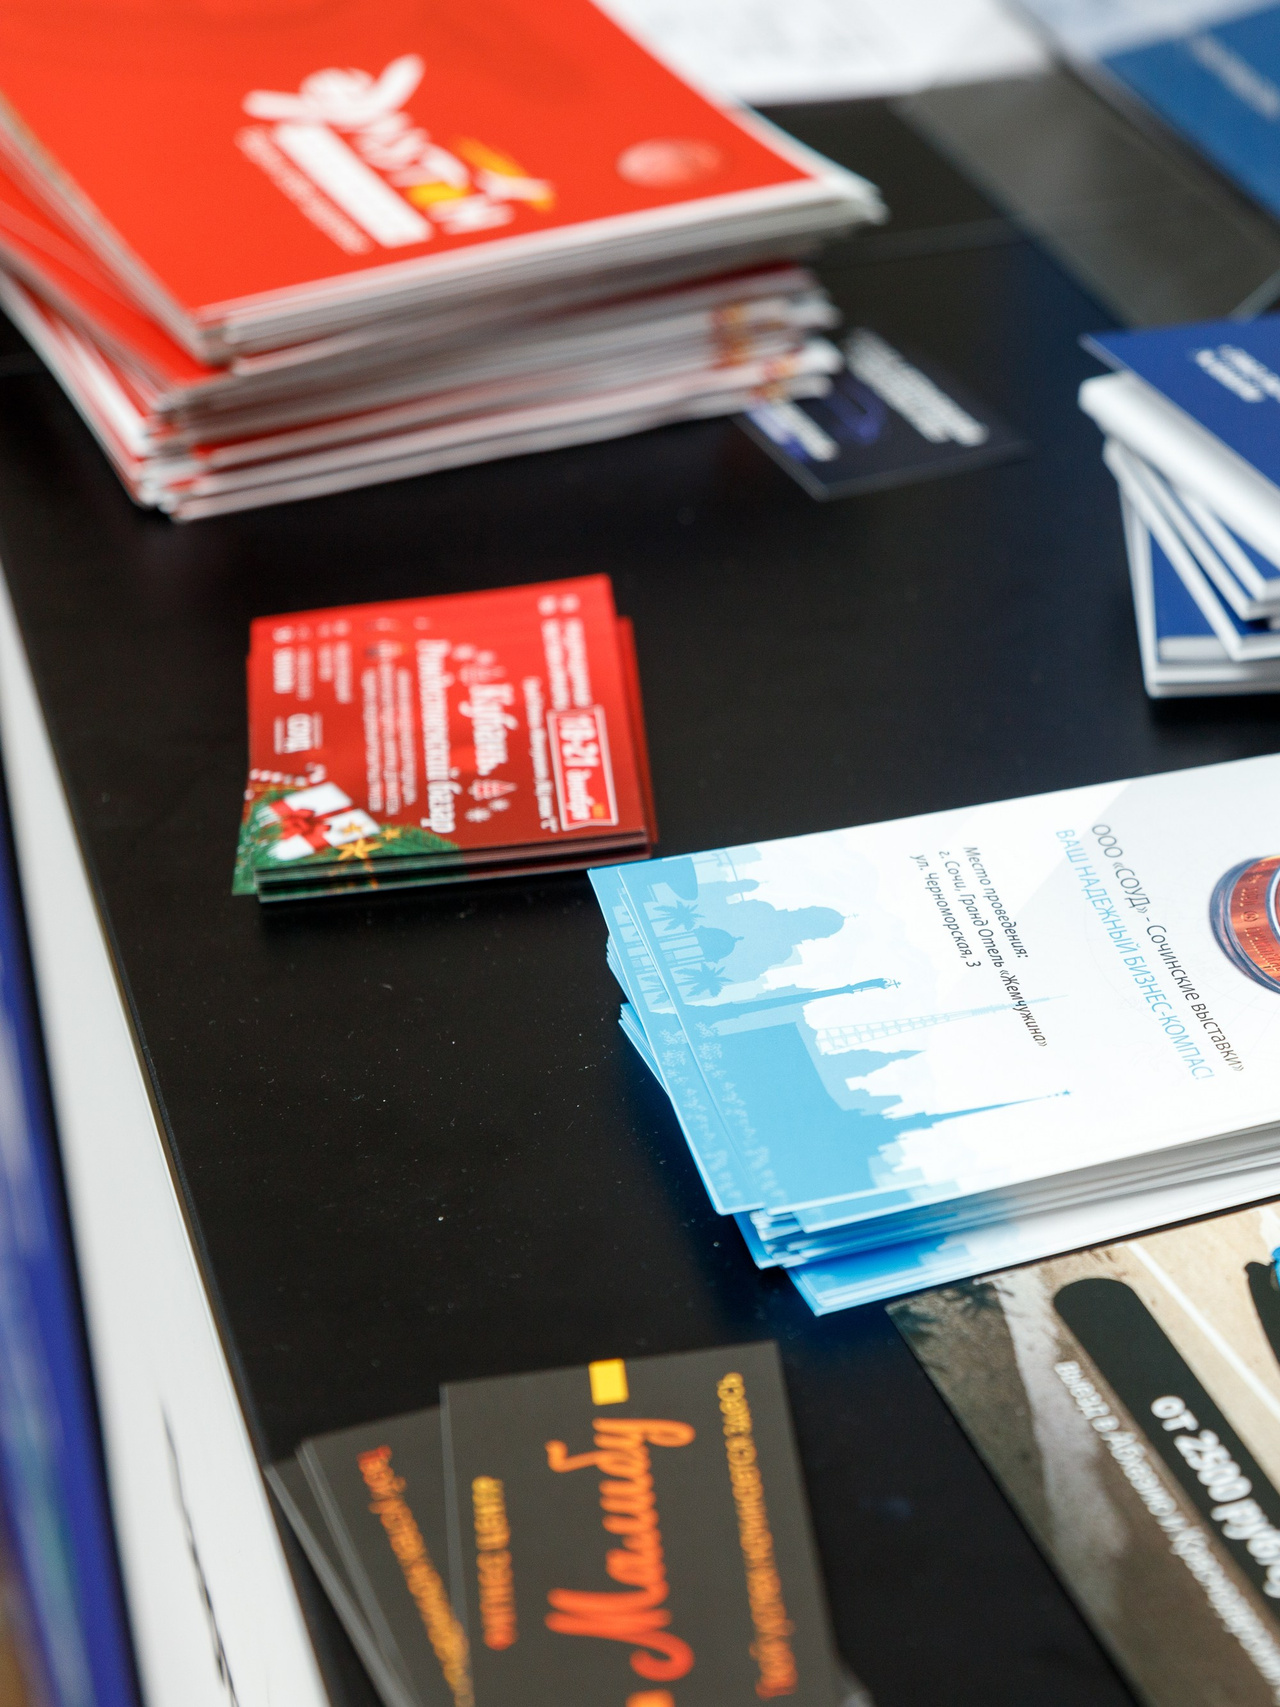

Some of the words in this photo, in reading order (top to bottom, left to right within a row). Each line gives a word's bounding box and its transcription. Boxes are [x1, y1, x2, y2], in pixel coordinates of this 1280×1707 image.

[910, 854, 928, 870] ул.
[925, 872, 973, 960] Черноморская,
[944, 861, 962, 892] Сочи,
[956, 892, 987, 928] Гранд
[977, 928, 1003, 968] Отель
[999, 969, 1048, 1048] «Жемчужина»
[963, 847, 992, 885] Место
[981, 885, 1029, 959] проведения:
[1056, 828, 1087, 862] ВАШ
[1075, 864, 1140, 955] НАДЕЖНЫЙ
[1123, 954, 1215, 1081] БИЗНЕС-КОМПАС!
[1092, 823, 1123, 858] ООО
[1113, 861, 1150, 915] «СОУД»
[1147, 925, 1201, 1001] Сочинские
[1151, 1396, 1198, 1431] от
[1174, 1430, 1252, 1502] 2500
[544, 1417, 695, 1681] Малибу
